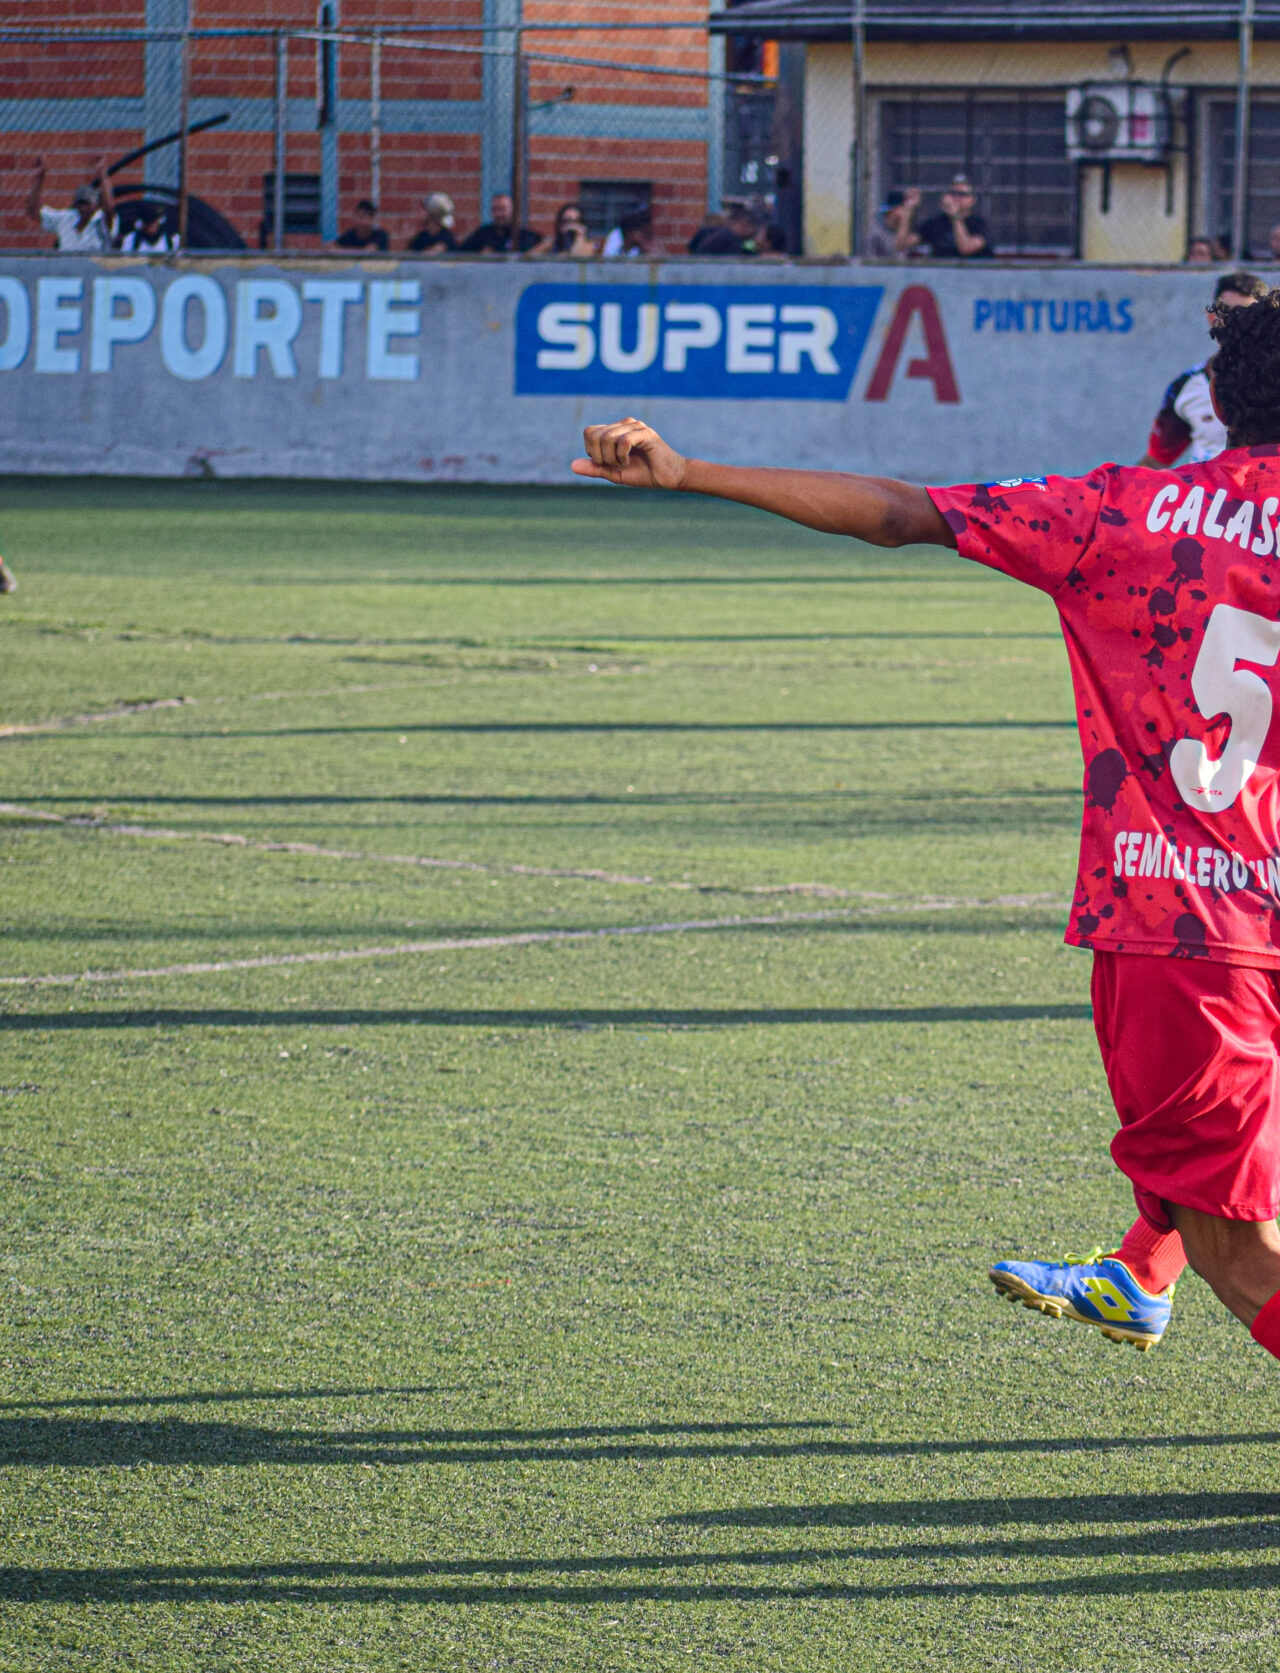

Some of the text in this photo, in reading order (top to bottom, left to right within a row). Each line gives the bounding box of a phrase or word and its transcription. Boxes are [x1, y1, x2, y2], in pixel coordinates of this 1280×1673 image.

[536, 284, 962, 405] SUPER A
[972, 297, 1135, 334] PINTURAS
[1113, 831, 1249, 892] SEMILLERO
